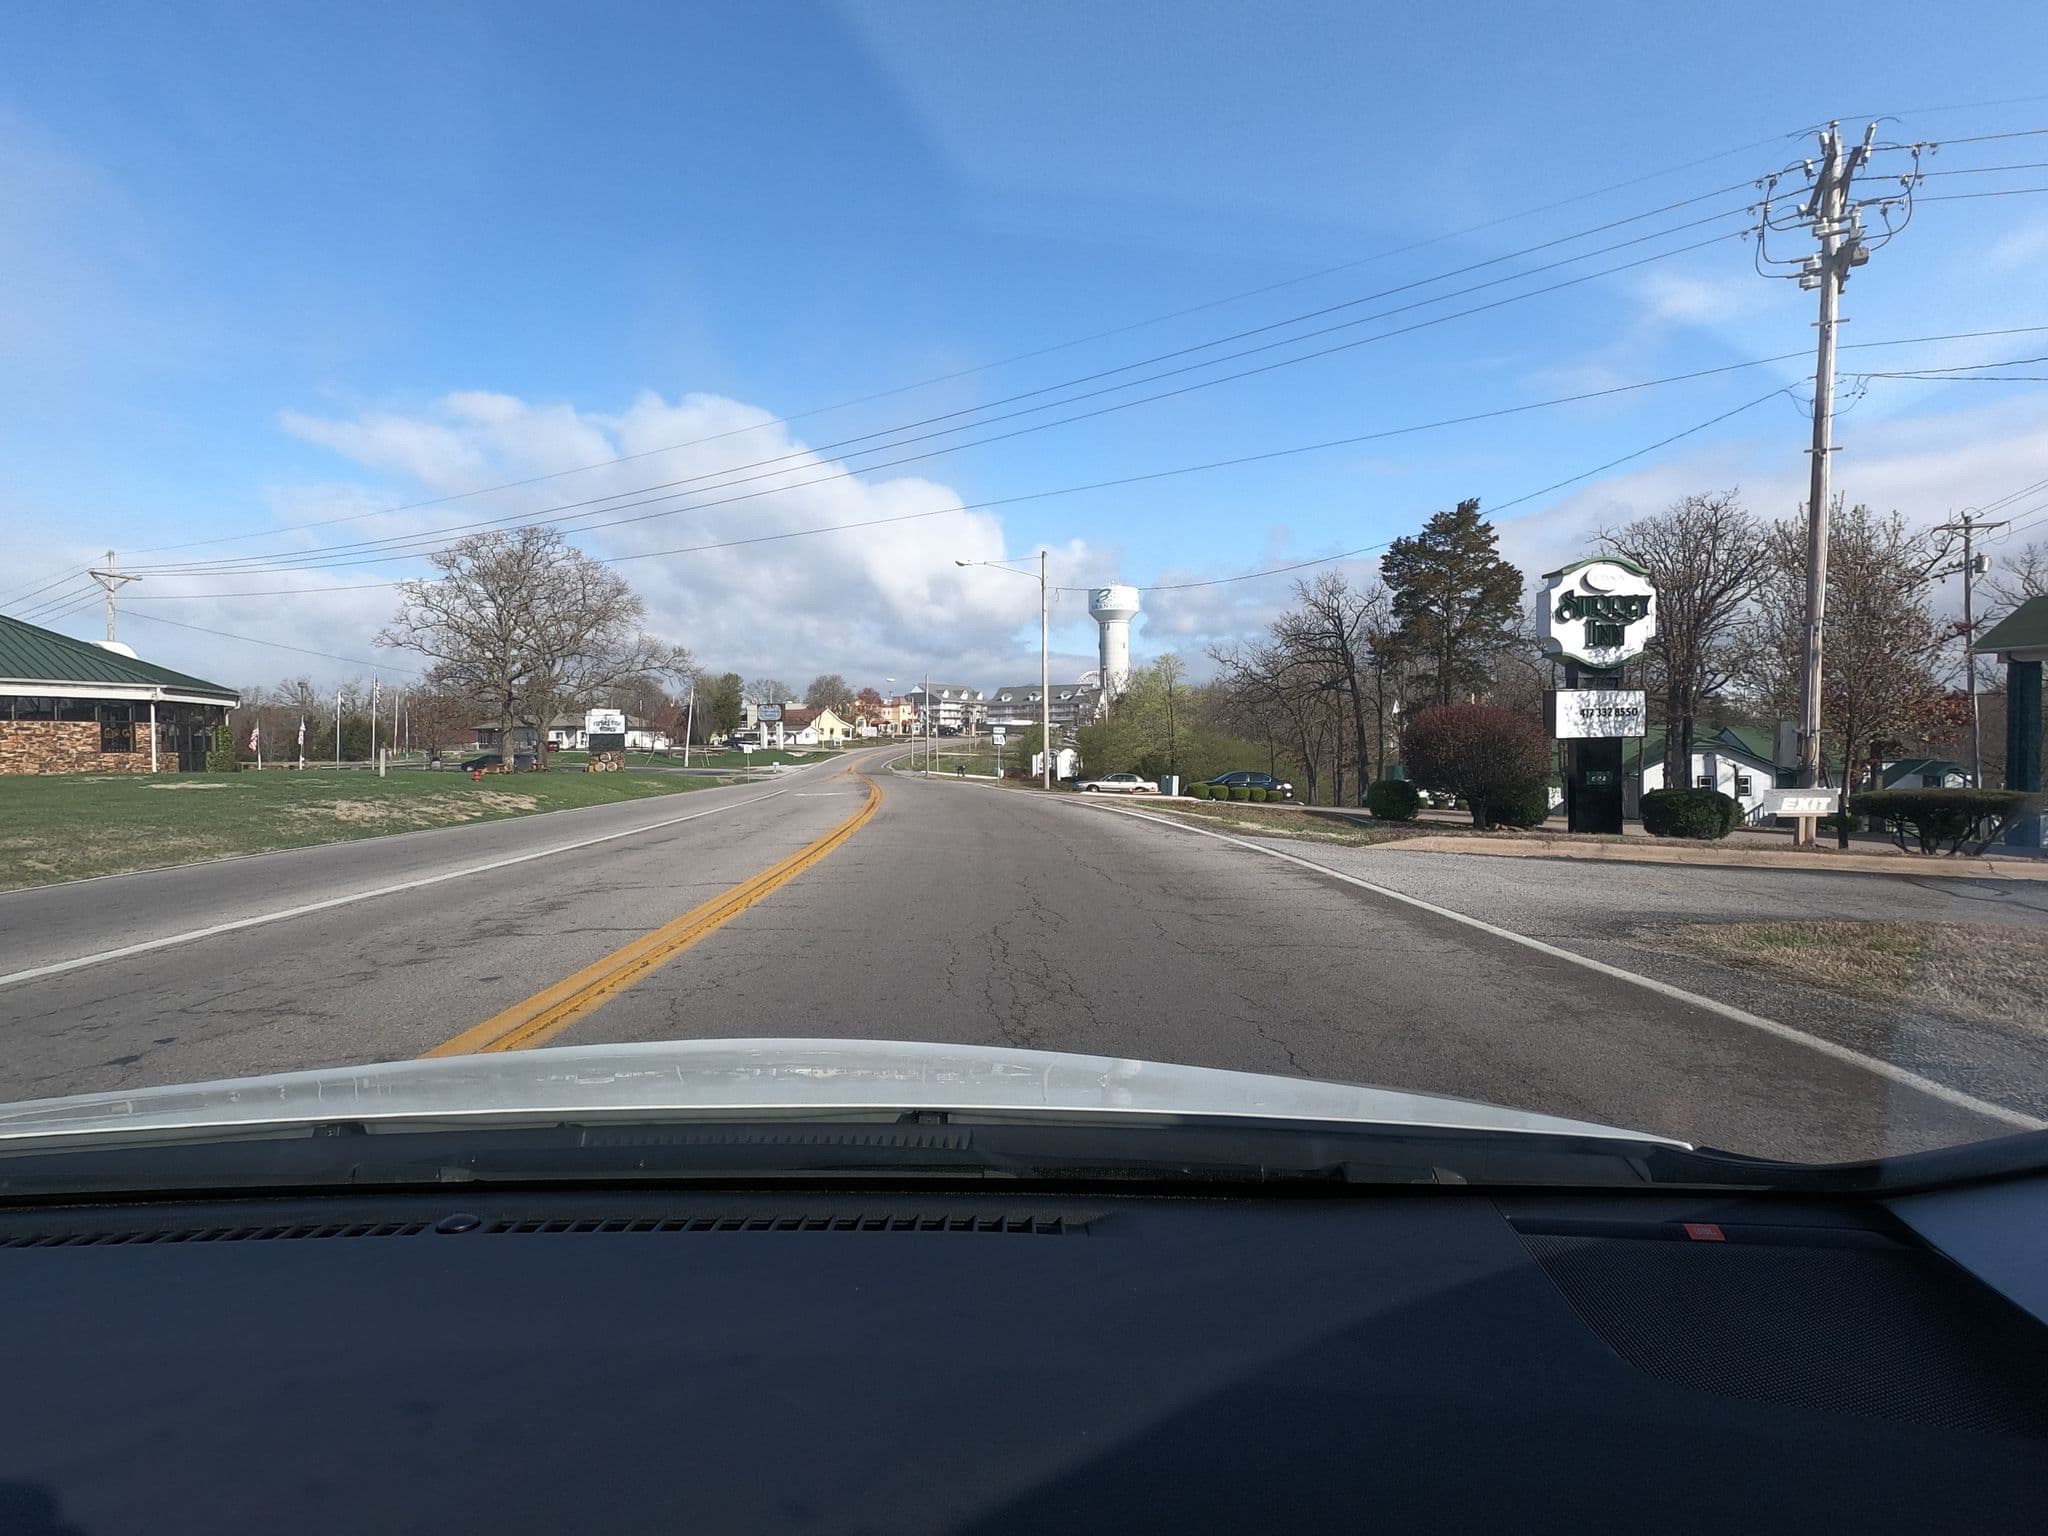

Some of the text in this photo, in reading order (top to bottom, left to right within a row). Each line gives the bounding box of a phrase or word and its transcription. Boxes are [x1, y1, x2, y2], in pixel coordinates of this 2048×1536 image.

[1580, 707, 1638, 718] 417 332 8550
[1782, 797, 1832, 811] EXIT
